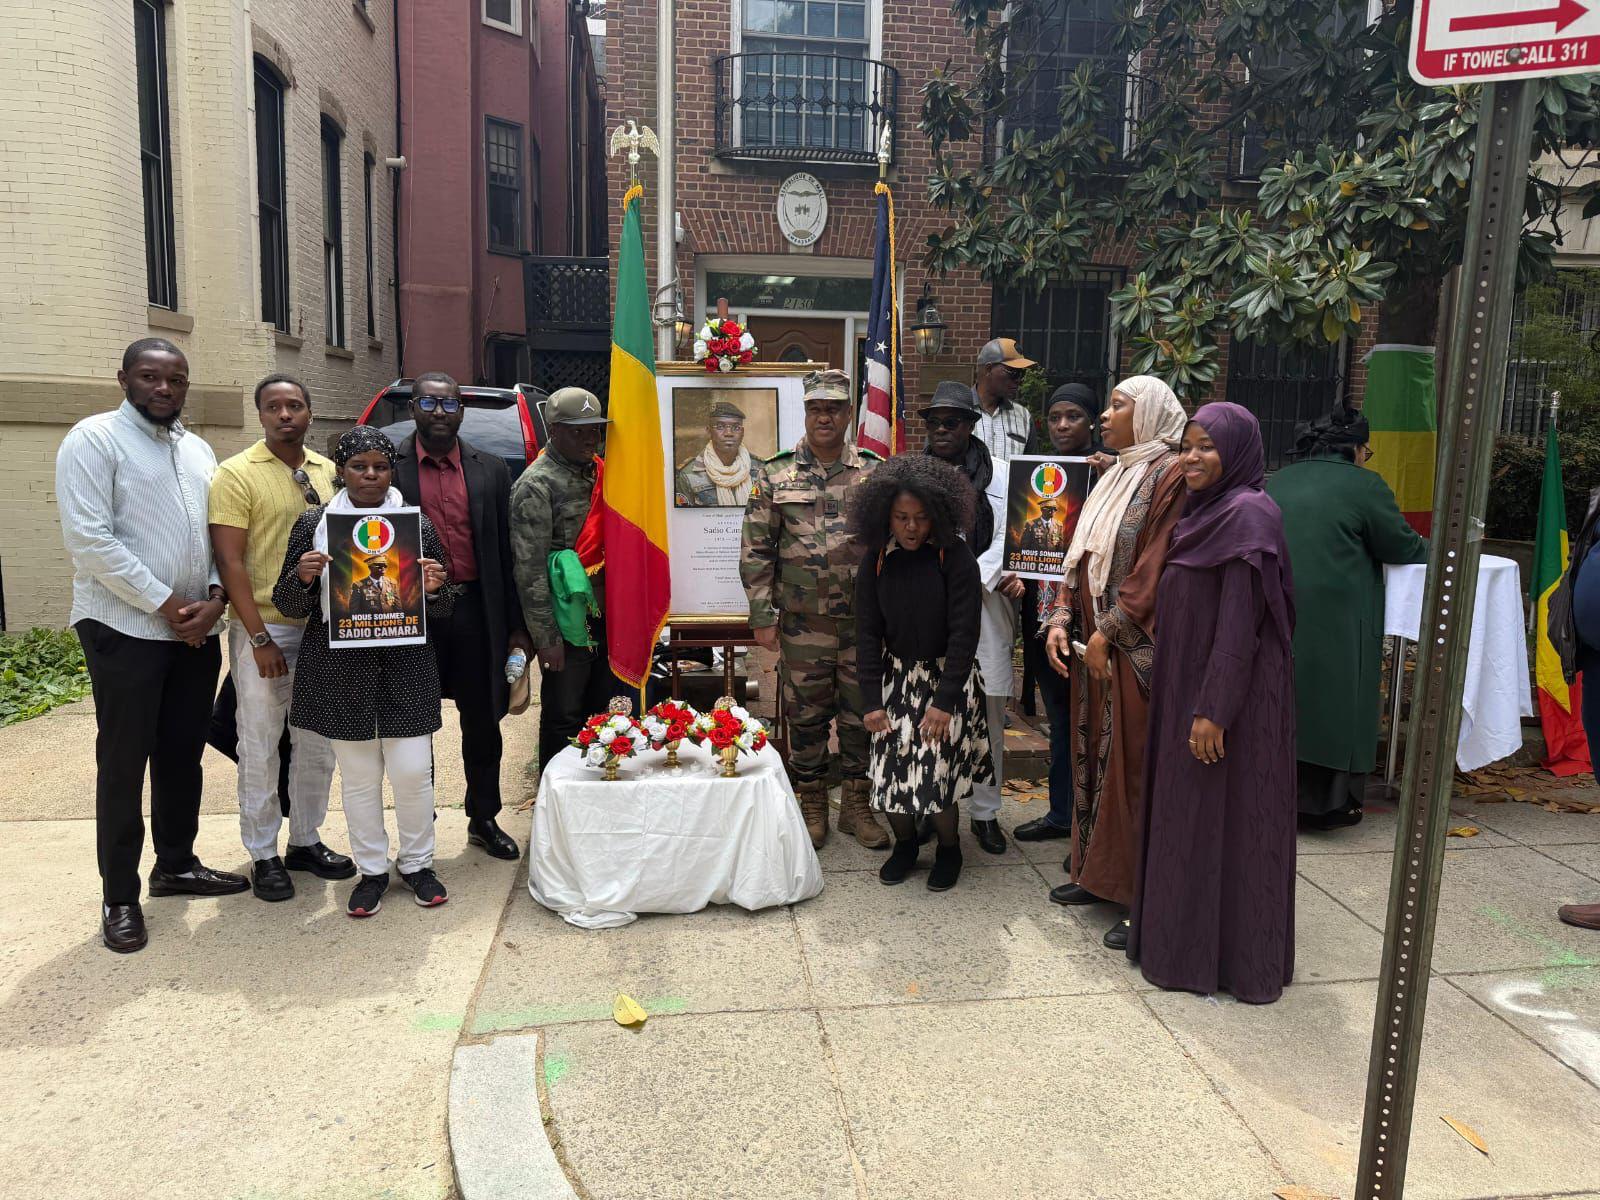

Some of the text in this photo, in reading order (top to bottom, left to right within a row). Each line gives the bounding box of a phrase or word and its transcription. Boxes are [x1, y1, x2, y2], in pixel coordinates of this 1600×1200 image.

[1443, 53, 1457, 71] IF
[1560, 40, 1588, 62] 311
[815, 183, 825, 199] MALI
[787, 233, 817, 245] AMBASSADE
[784, 297, 816, 310] 2130
[1009, 552, 1062, 564] 23 MILLIONS
[1021, 549, 1038, 557] NOUS
[1008, 560, 1066, 574] SADIO CAMAR
[338, 615, 419, 629] 23 MILLIONS DE
[351, 612, 405, 621] NOUS SOMMES
[338, 627, 371, 639] SADIO
